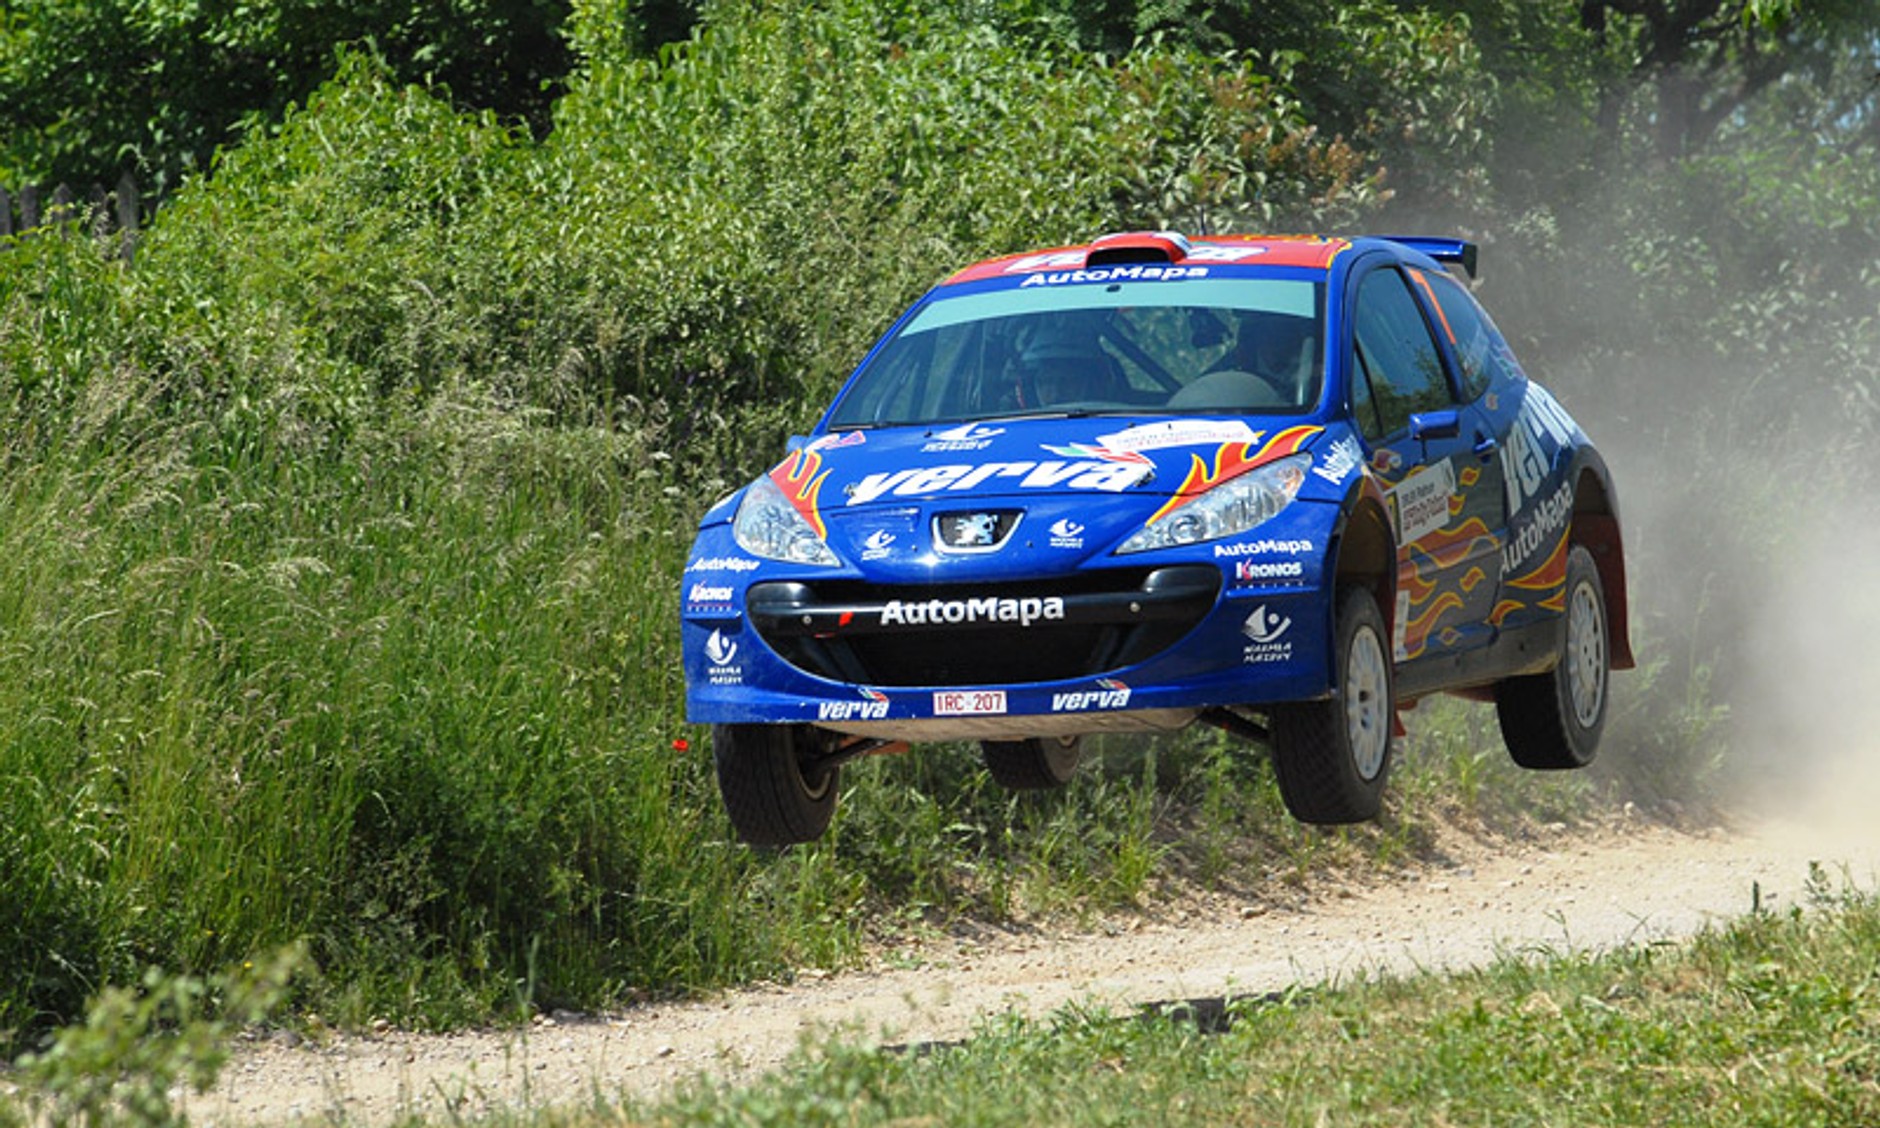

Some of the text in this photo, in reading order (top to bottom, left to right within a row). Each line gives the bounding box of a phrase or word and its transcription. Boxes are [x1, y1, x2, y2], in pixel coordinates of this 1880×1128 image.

[1020, 266, 1209, 287] AutoMapa
[847, 460, 1151, 506] verva
[1501, 480, 1574, 573] AutoMapa
[1214, 539, 1313, 557] AutoMapa
[1236, 557, 1303, 580] KRONOS
[881, 596, 1065, 626] AutoMapa
[818, 701, 890, 719] verva
[1052, 689, 1132, 711] verva
